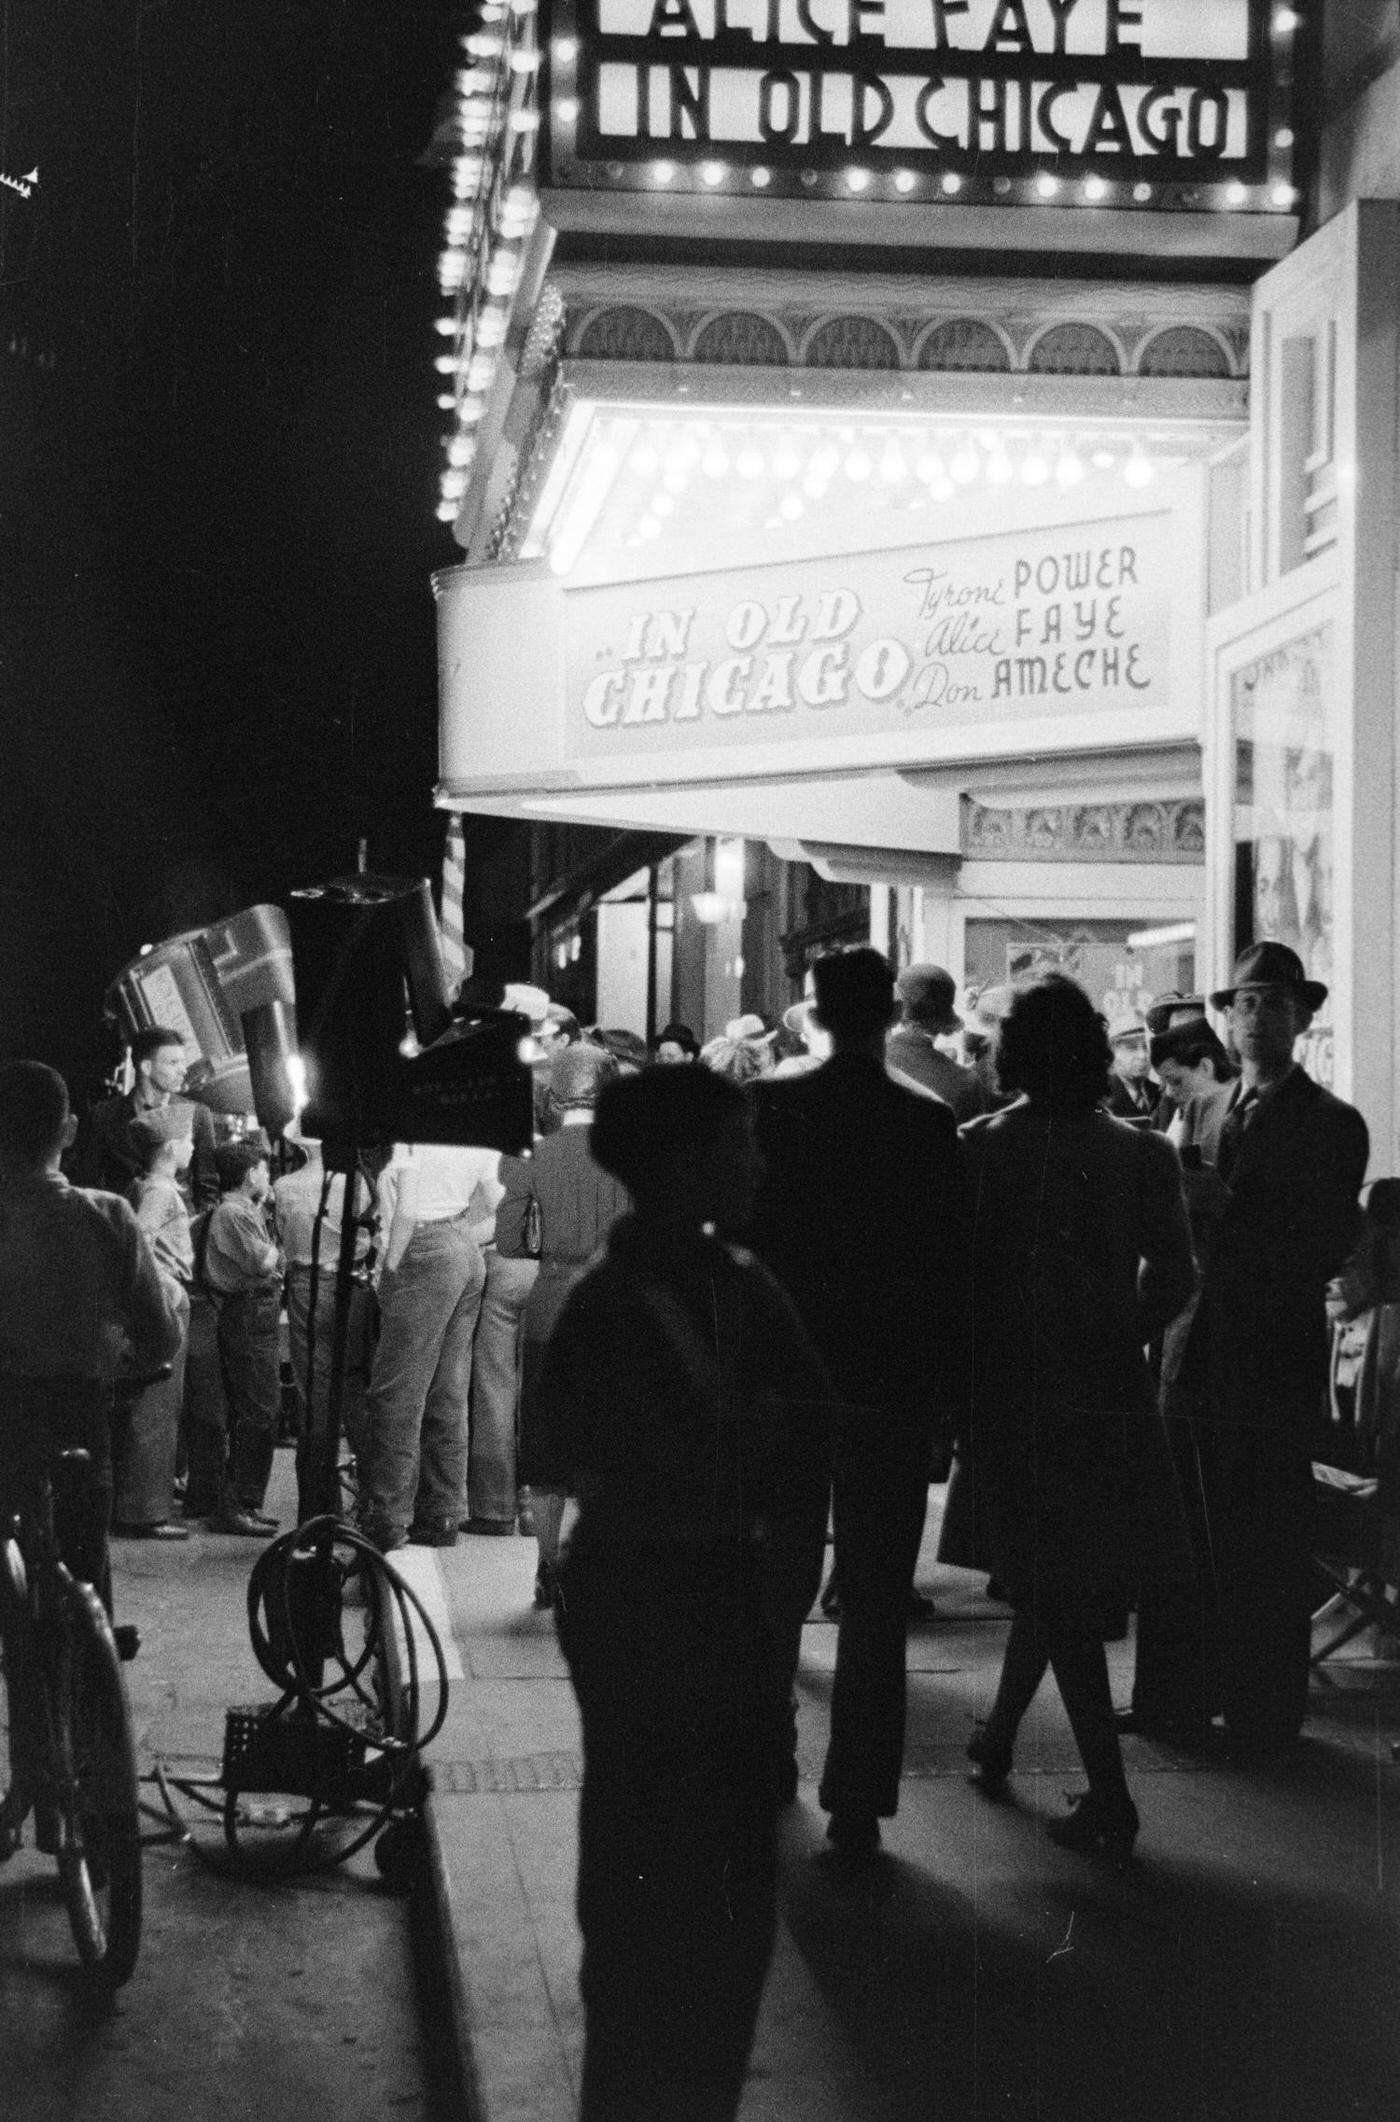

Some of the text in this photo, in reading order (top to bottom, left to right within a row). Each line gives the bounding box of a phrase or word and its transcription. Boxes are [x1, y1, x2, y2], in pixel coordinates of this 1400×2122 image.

[646, 0, 1142, 58] ALICE FAYE
[636, 63, 1228, 158] IN OLD CHICAGO
[903, 546, 1139, 617] Tyrone POWER
[726, 587, 864, 652] OLD
[923, 596, 1126, 657] Alice FAYE
[912, 642, 1151, 710] Don AMECHE
